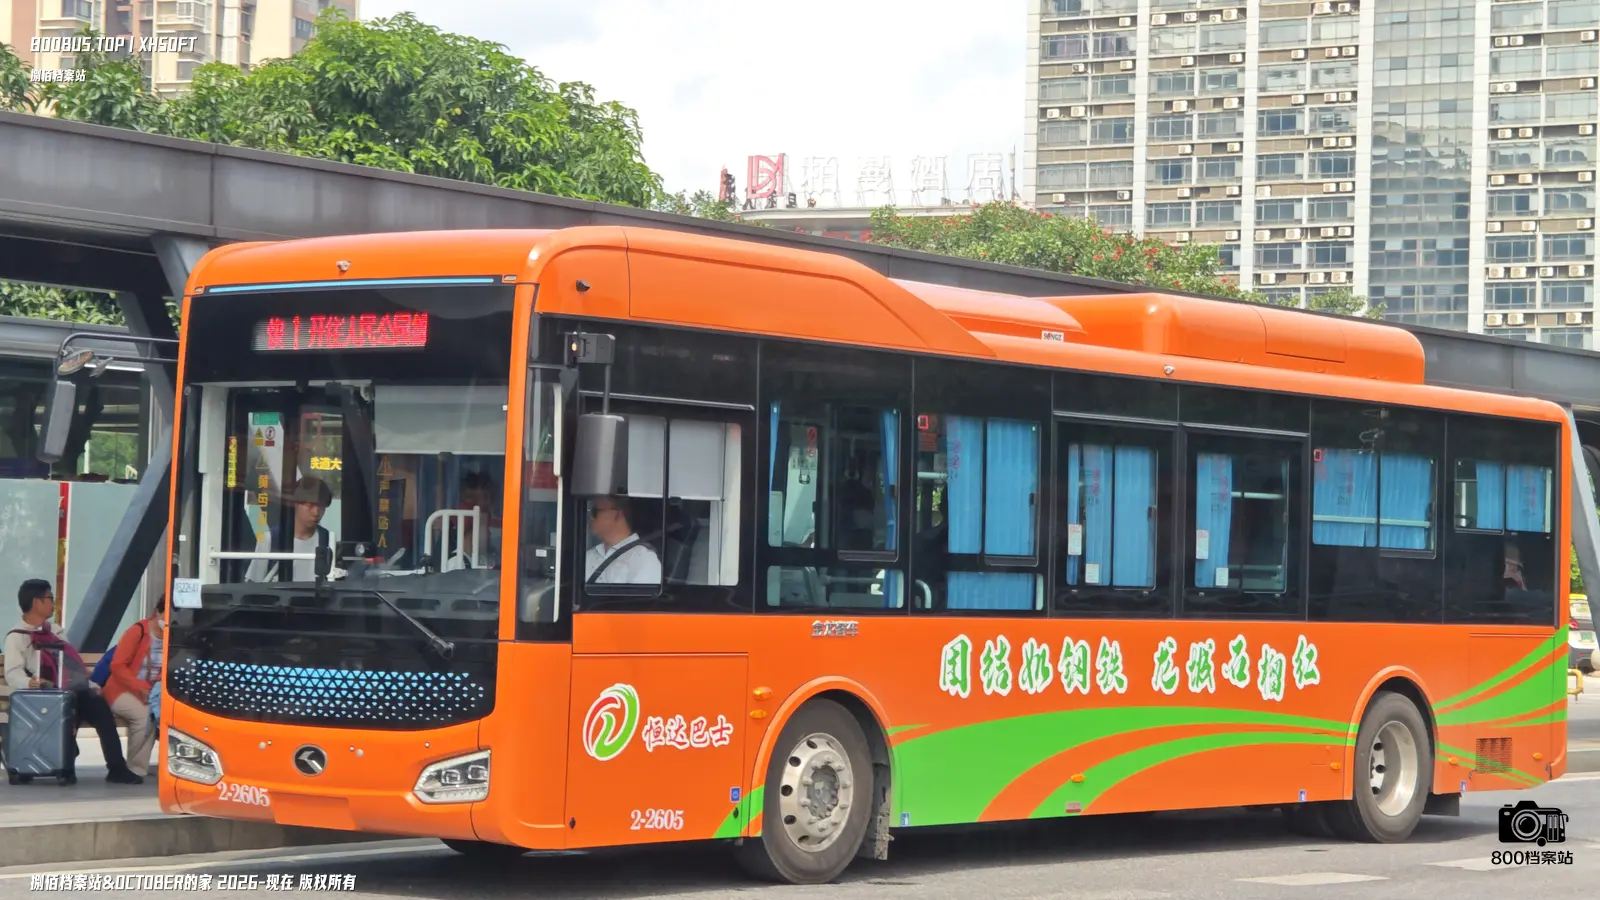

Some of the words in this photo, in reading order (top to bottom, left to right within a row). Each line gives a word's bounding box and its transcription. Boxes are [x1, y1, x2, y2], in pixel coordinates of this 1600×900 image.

[801, 153, 1003, 193] 柏曼酒店
[940, 634, 1128, 698] 团结如钢铁
[1152, 634, 1320, 701] 龙城石榴红
[642, 715, 733, 752] 恒达巴士
[217, 781, 270, 807] 2-2605
[630, 808, 684, 830] 2-2605
